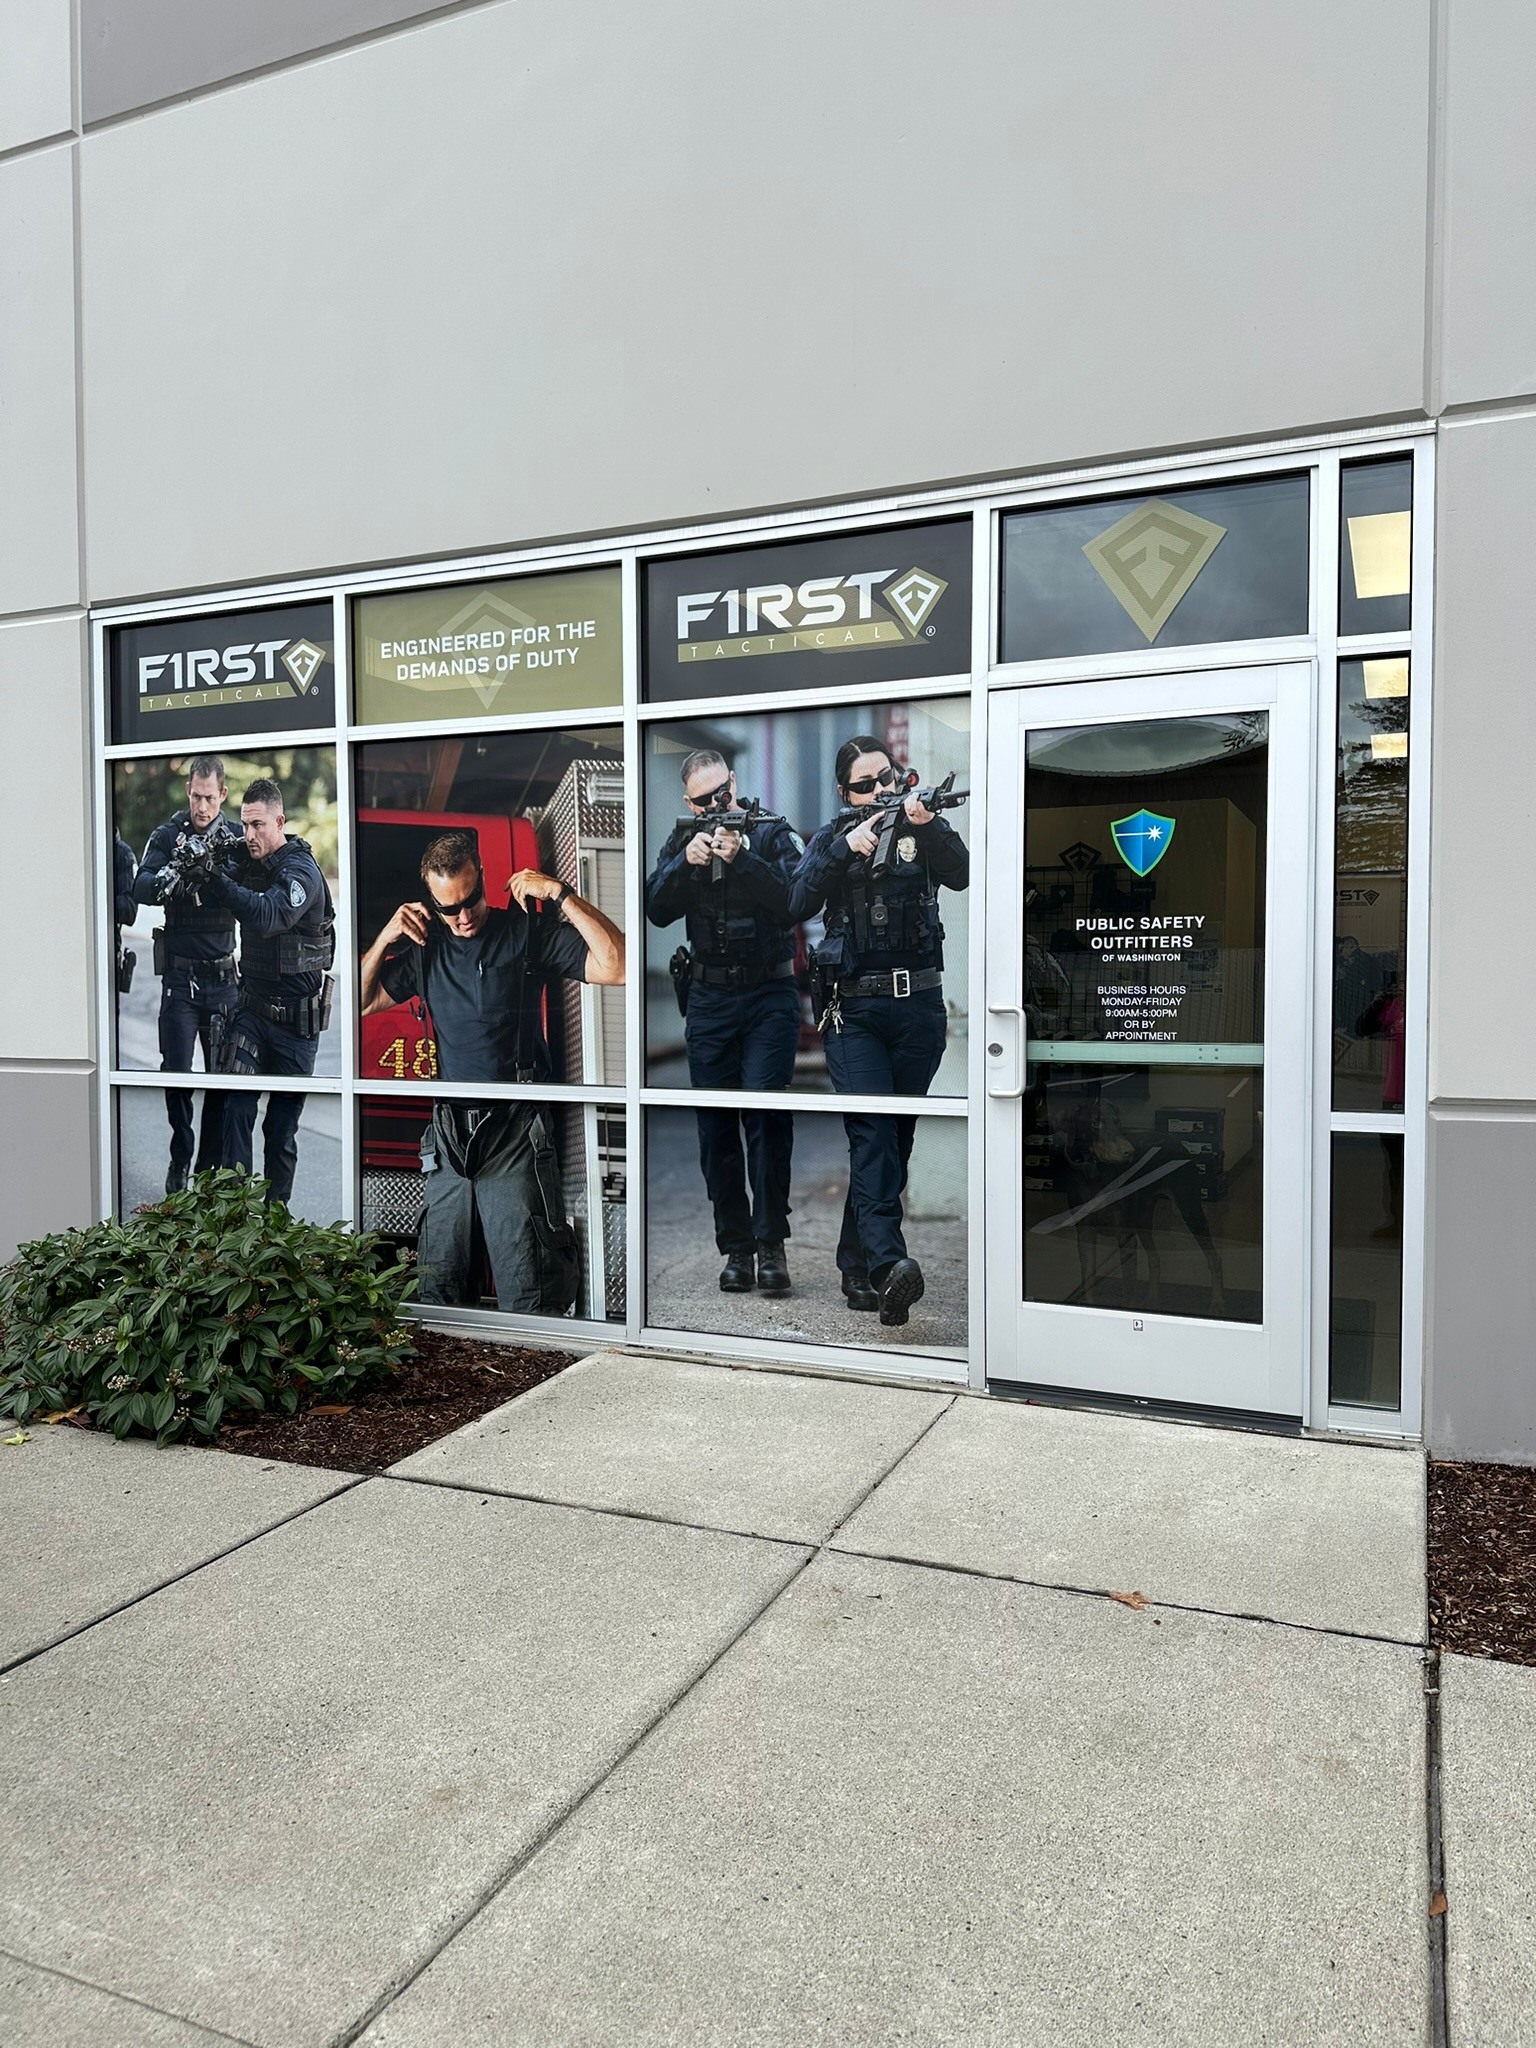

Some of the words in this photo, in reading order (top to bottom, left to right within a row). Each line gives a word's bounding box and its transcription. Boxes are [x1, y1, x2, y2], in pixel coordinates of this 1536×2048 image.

[677, 568, 898, 640] F1RST
[381, 630, 505, 660] ENGINEERED
[511, 624, 551, 646] FOR
[556, 620, 596, 641] THE
[691, 626, 881, 658] TACTICAL
[138, 638, 291, 694] F1RST
[397, 656, 490, 681] DEMANDS
[495, 652, 520, 672] OF
[527, 646, 580, 669] DUTY
[149, 688, 281, 708] TACTICAL
[1076, 918, 1135, 931] PUBLIC
[1140, 915, 1205, 930] SAFETY
[1091, 935, 1193, 949] OUTFITTERS
[1102, 954, 1115, 962] OF
[1117, 953, 1181, 962] WASHINGTON
[1097, 986, 1147, 995] BUSINESS
[1149, 986, 1187, 995] HOURS
[1101, 997, 1182, 1006] MONDAY-FRIDAY
[1105, 1009, 1178, 1018] 9:00AM-5:00PM
[1124, 1020, 1140, 1029] OR
[1141, 1020, 1156, 1029] BY
[1105, 1032, 1178, 1041] APPOINTMENT
[378, 1038, 437, 1079] 48
